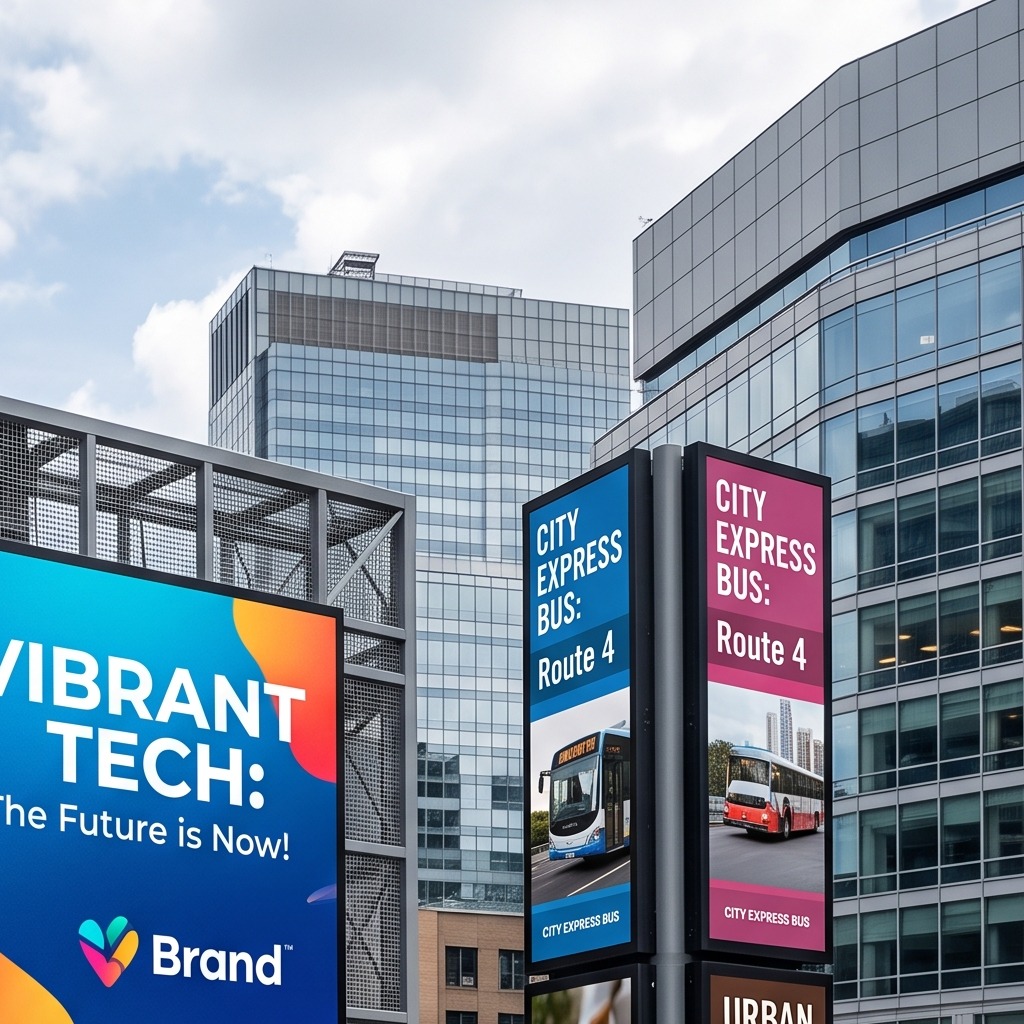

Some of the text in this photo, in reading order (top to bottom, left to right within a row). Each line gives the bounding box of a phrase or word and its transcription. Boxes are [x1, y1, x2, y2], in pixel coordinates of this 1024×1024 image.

[716, 479, 767, 522] CITY
[536, 508, 579, 556] CITY
[716, 520, 817, 576] EXPRESS
[537, 529, 623, 597] EXPRESS
[717, 562, 770, 606] BUS:
[537, 591, 581, 637] BUS:
[538, 629, 615, 691] Route 4
[717, 620, 807, 671] Route 4
[46, 720, 265, 810] TECH:
[59, 803, 167, 845] Future
[178, 816, 202, 849] is
[213, 824, 290, 861] Now!
[542, 910, 620, 939] CITY EXPRESS BUS
[724, 906, 810, 928] CITY EXPRESS BUS
